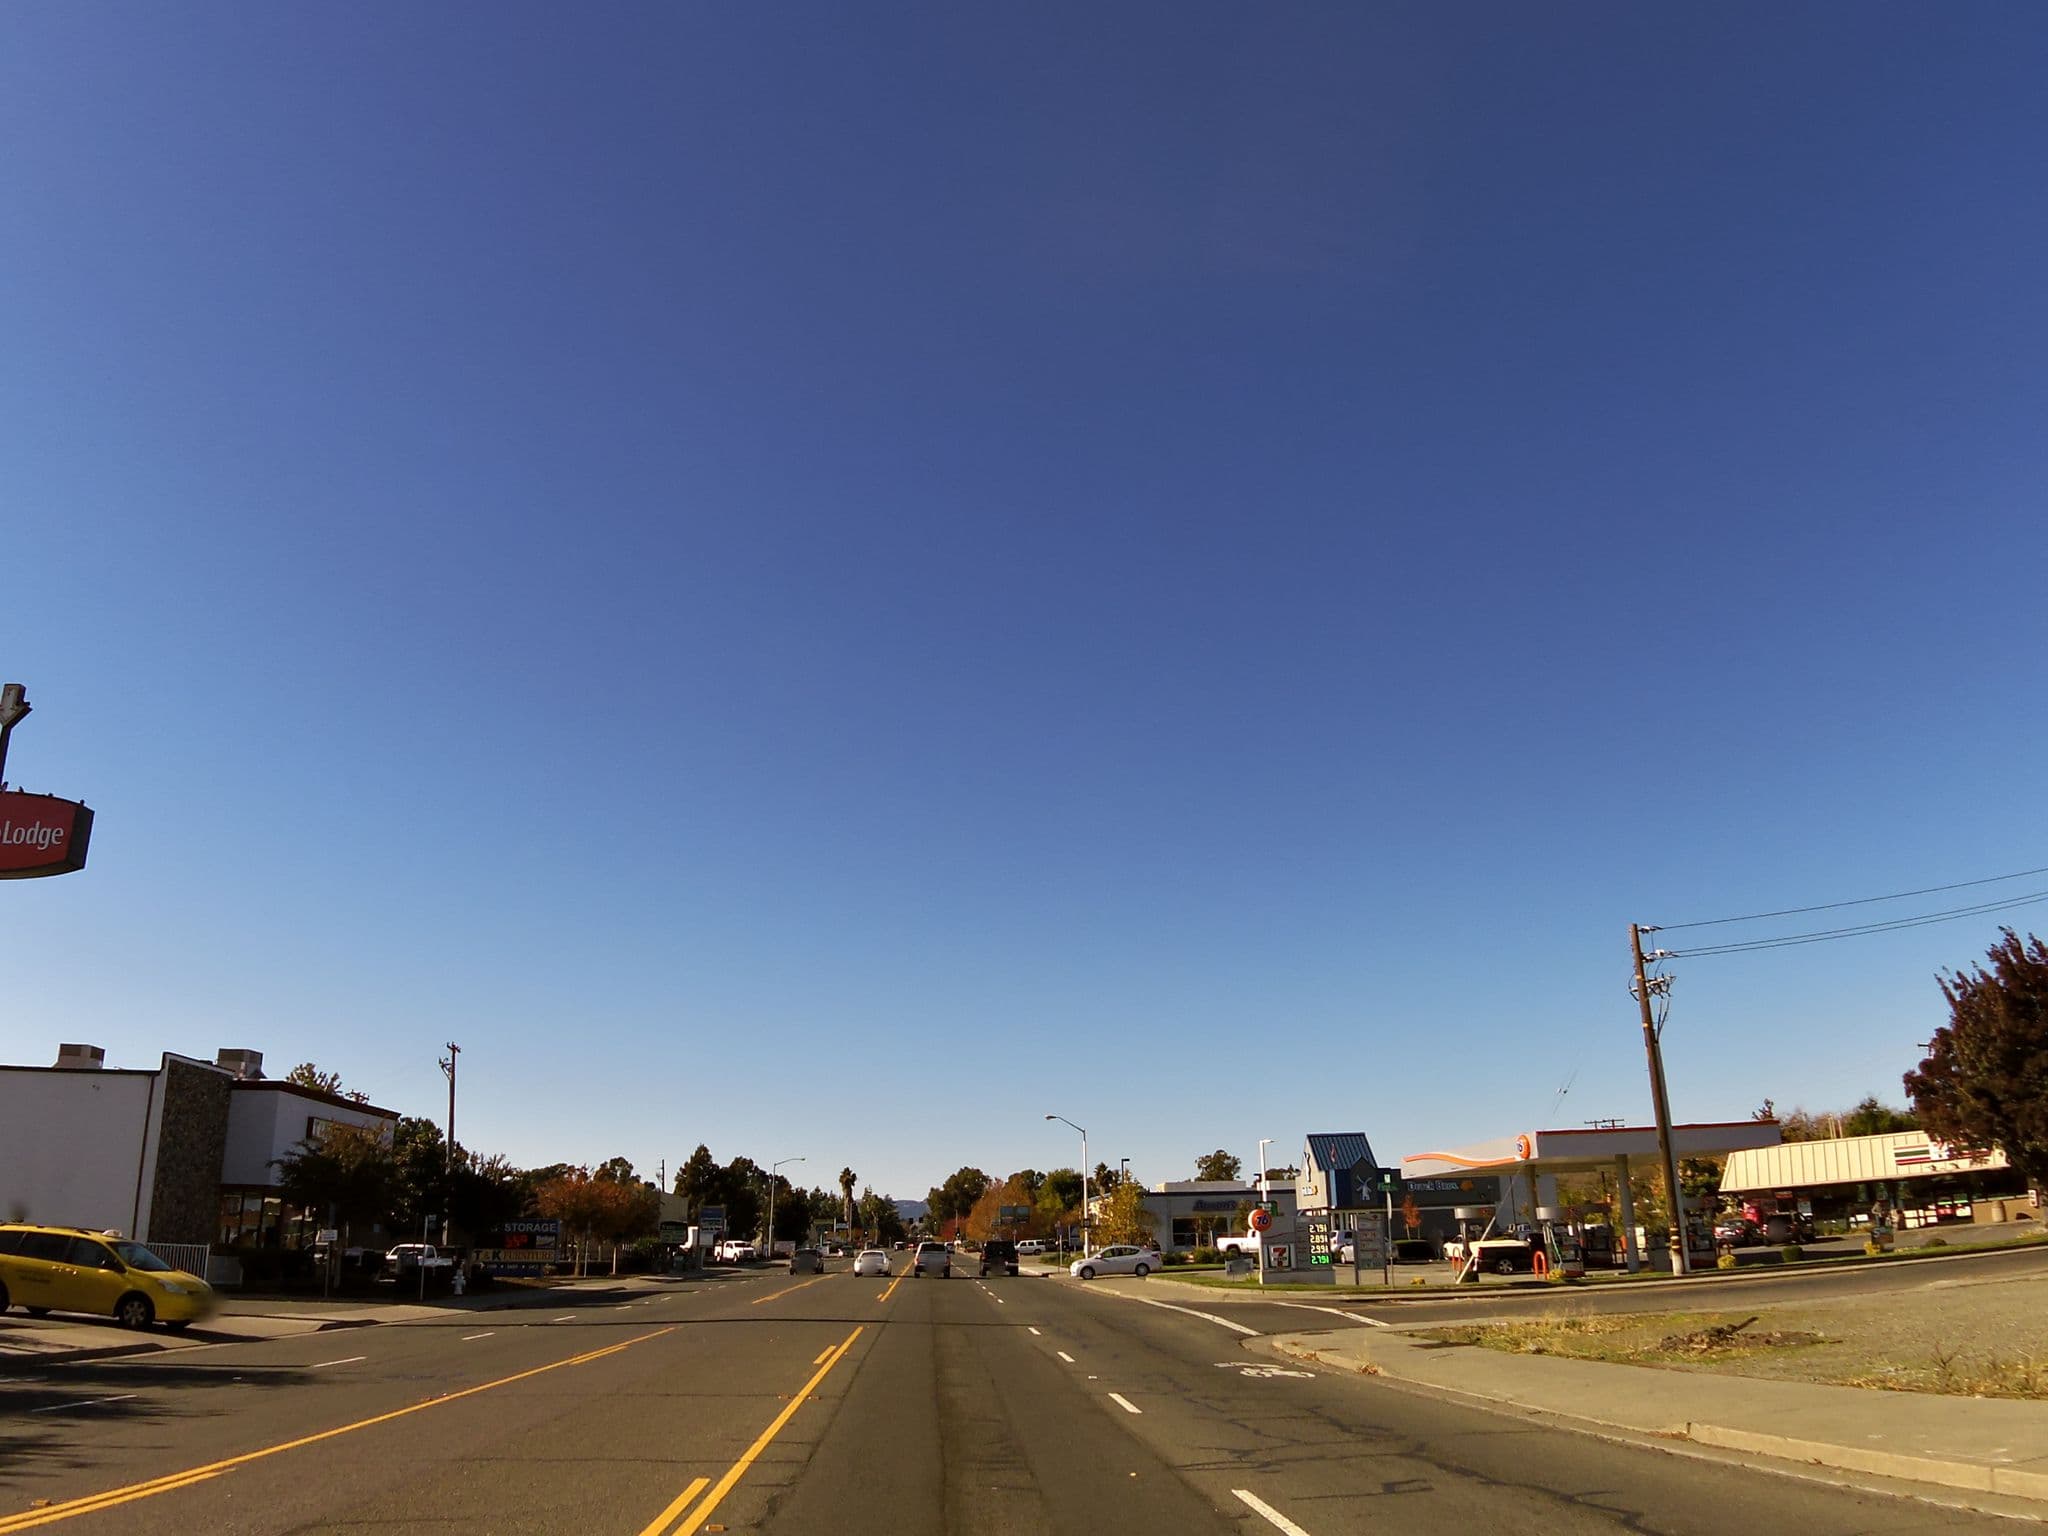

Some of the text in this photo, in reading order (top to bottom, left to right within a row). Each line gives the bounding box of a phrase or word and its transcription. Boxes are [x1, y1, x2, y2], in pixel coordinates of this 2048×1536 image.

[0, 820, 64, 850] Lodge
[1256, 1215, 1269, 1225] 76
[504, 1222, 557, 1232] STORAGE
